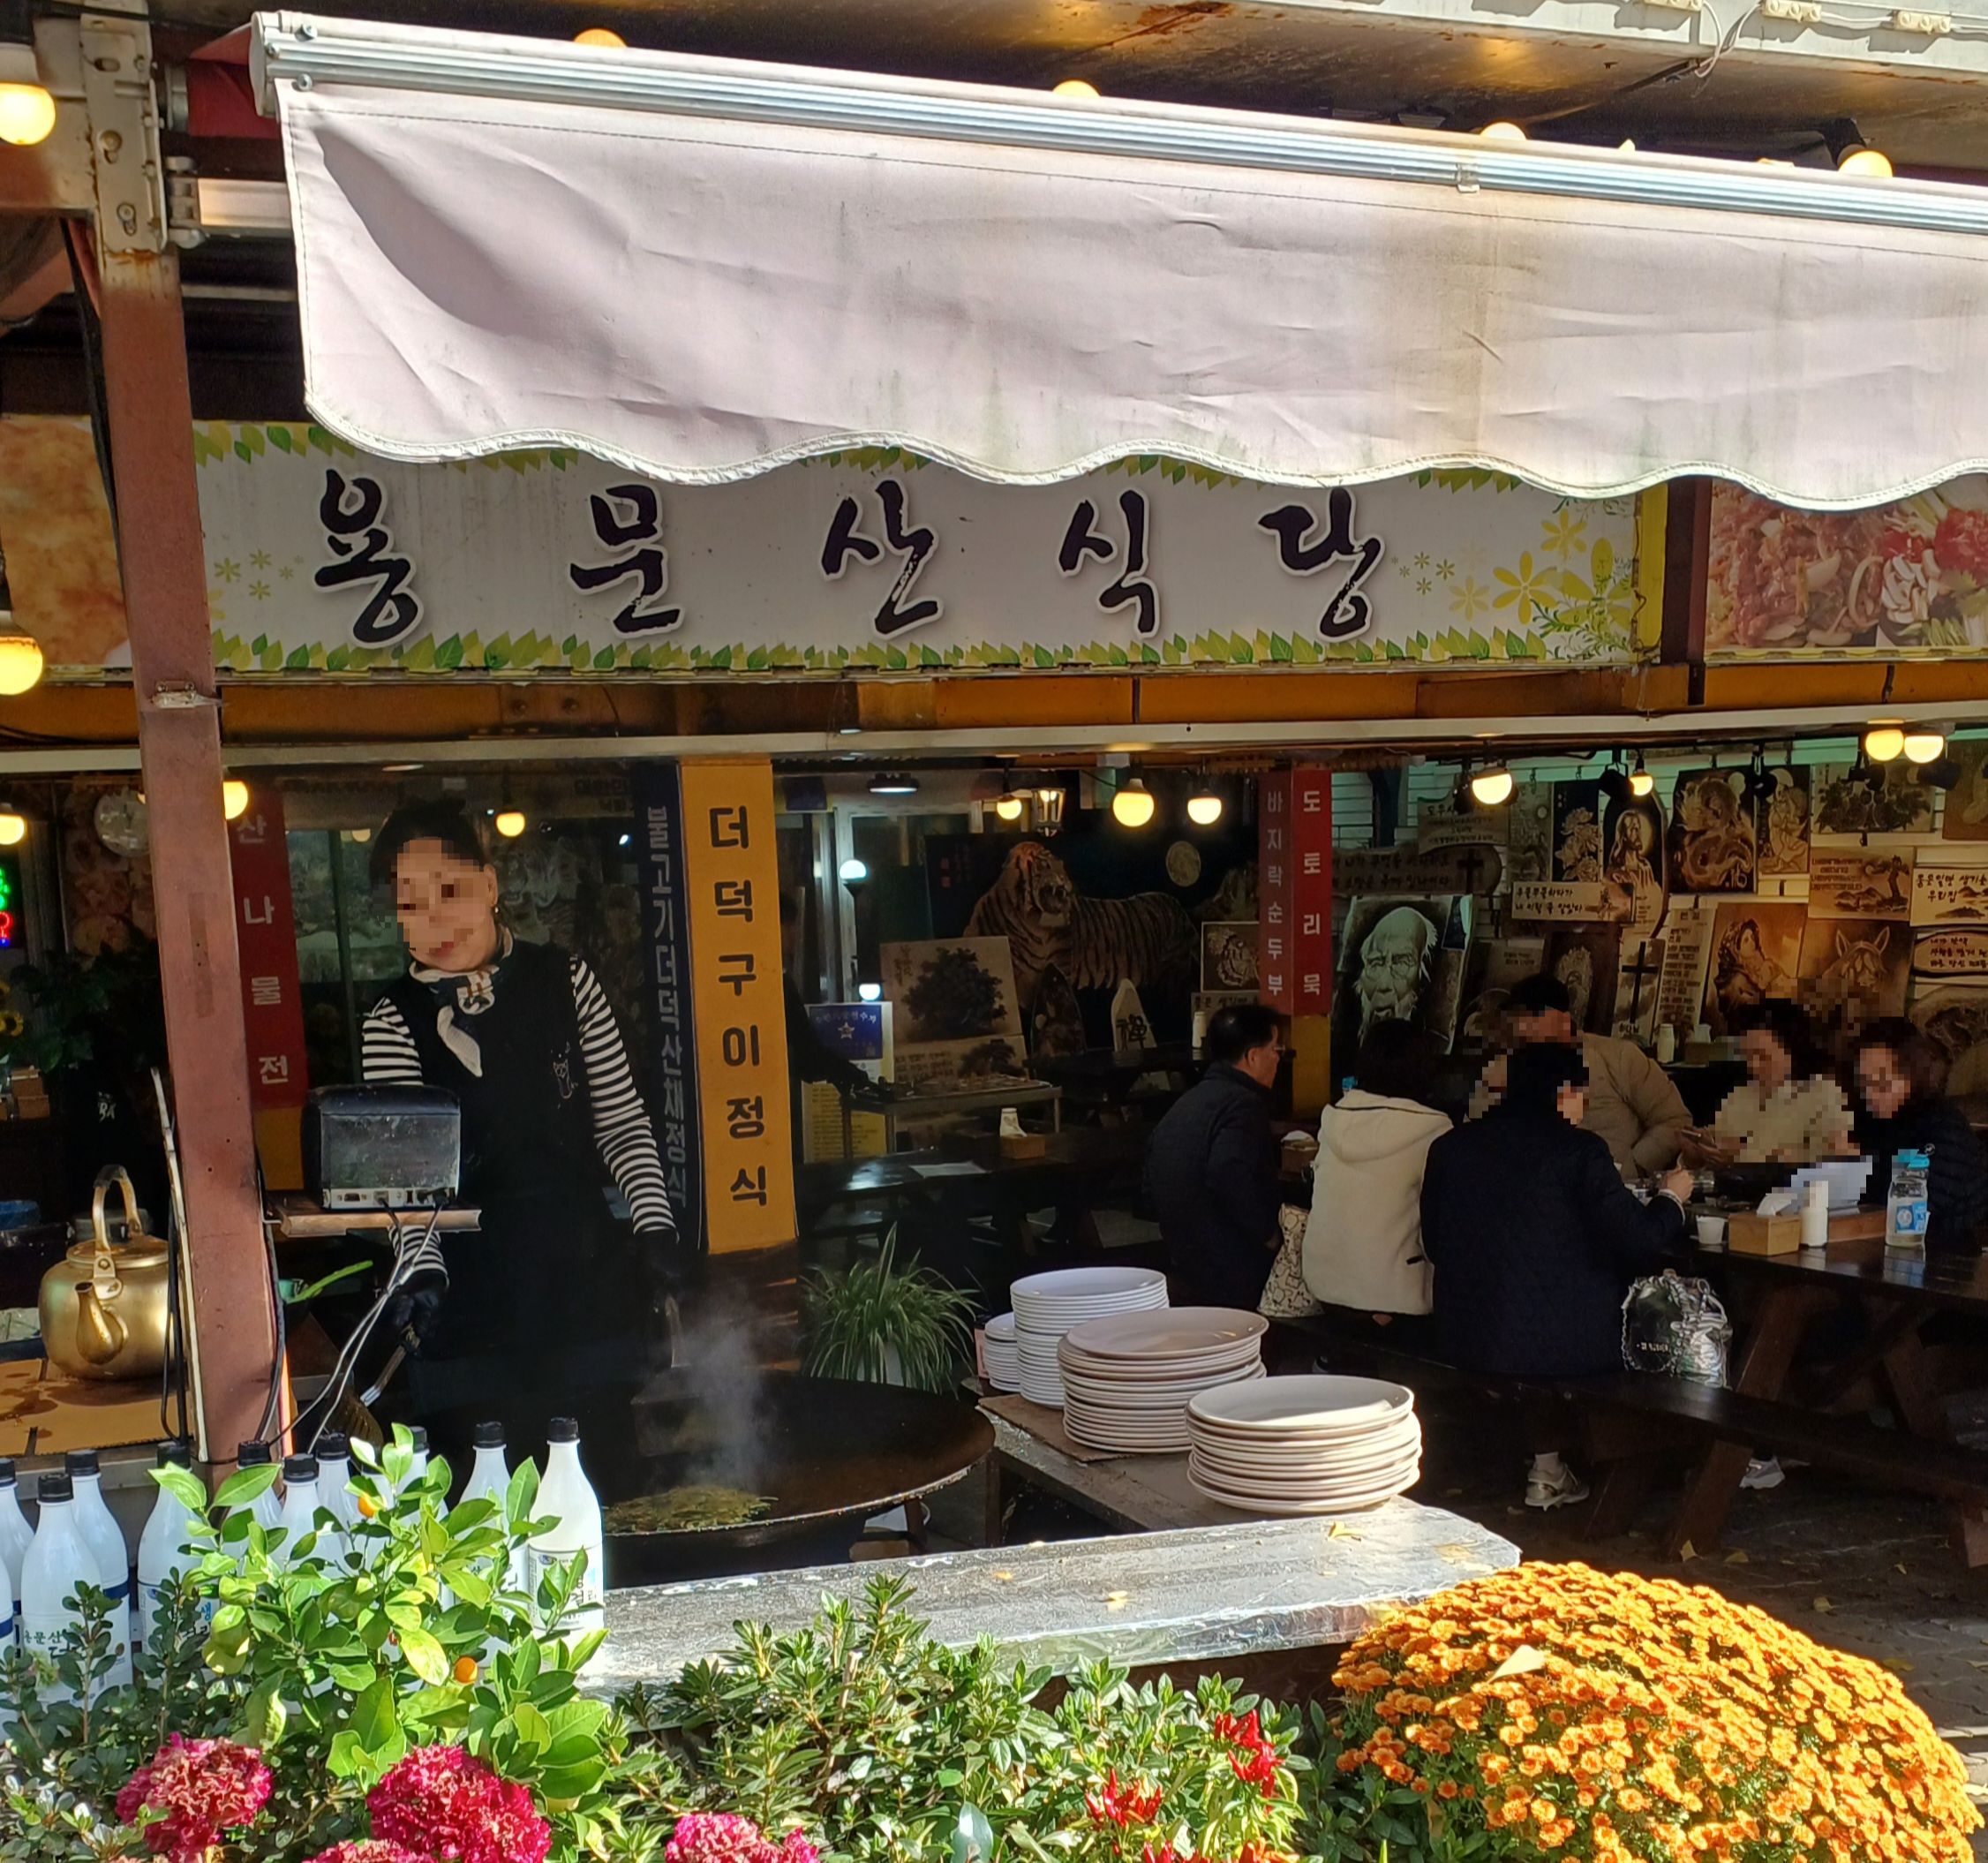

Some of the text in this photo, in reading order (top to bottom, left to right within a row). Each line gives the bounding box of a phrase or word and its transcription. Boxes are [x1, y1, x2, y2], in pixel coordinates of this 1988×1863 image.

[236, 813, 290, 1085] 산나물전
[647, 805, 688, 1211] 불고기더덕산채정식
[708, 804, 768, 1207] 더덕구이정식
[1266, 789, 1284, 997] 바지락순두부
[1302, 789, 1322, 997] 도토리묵
